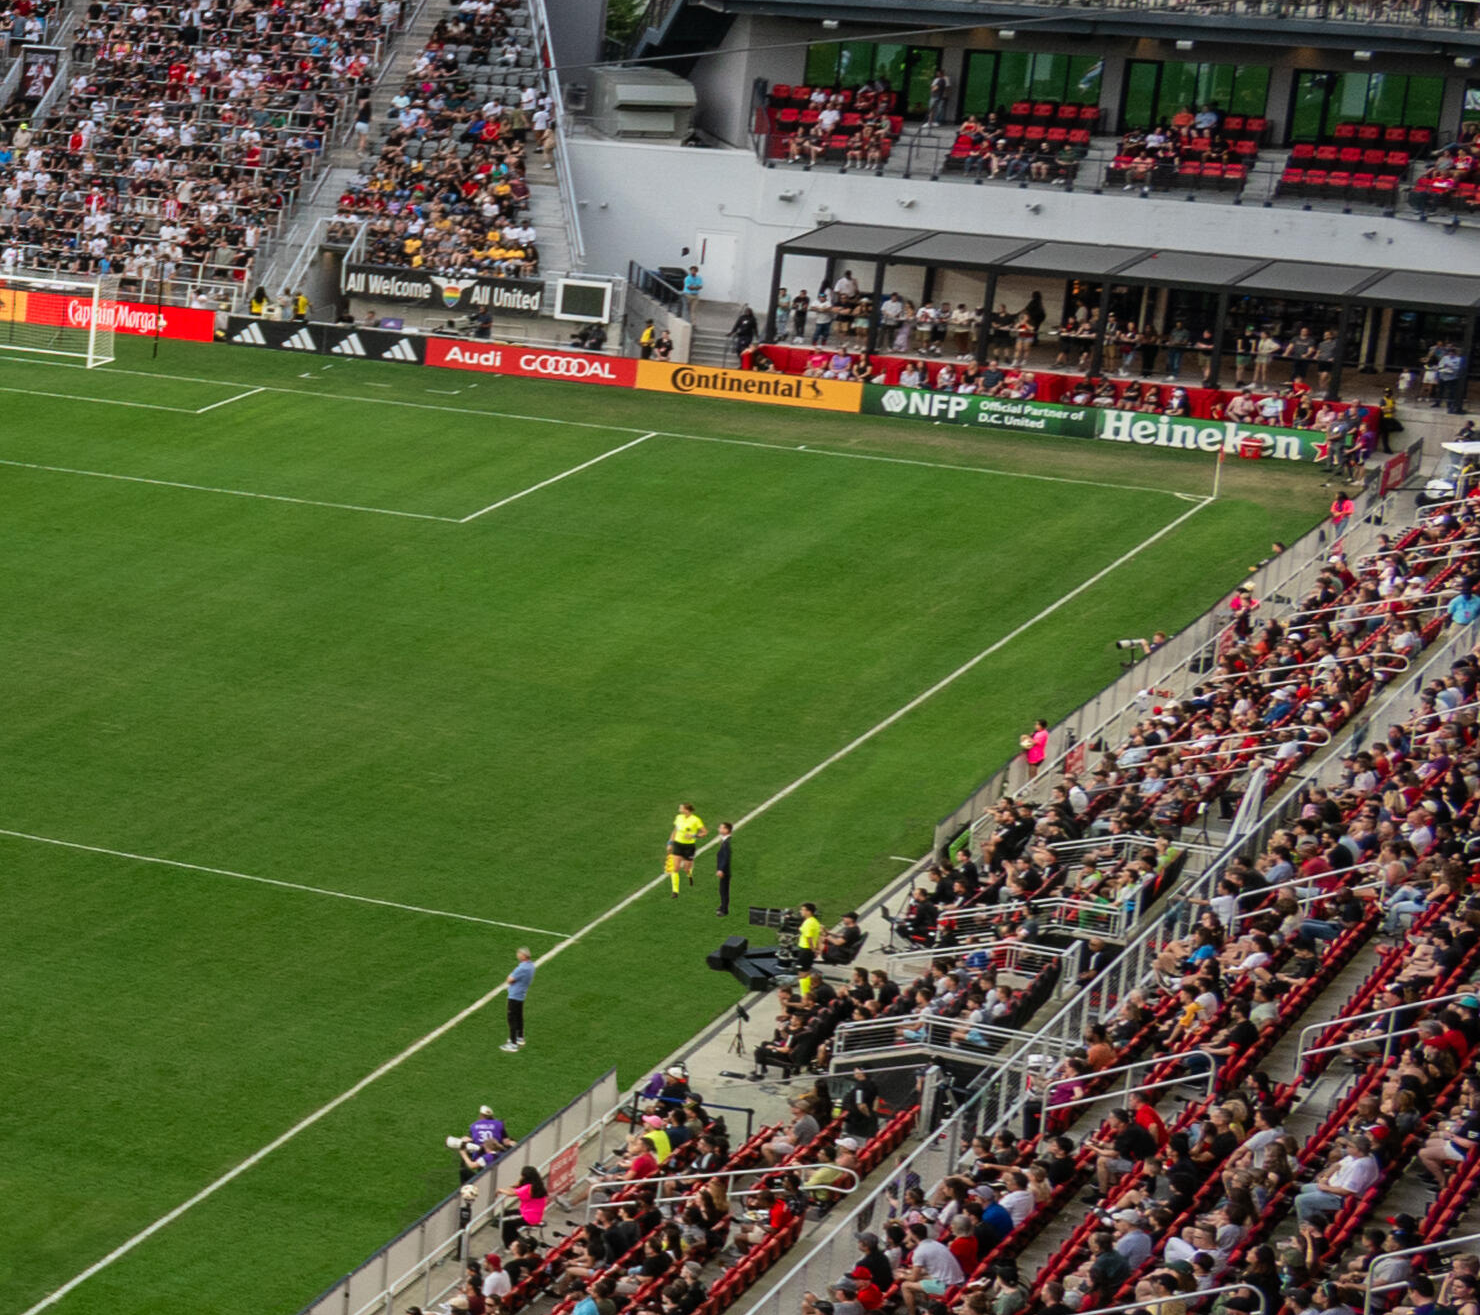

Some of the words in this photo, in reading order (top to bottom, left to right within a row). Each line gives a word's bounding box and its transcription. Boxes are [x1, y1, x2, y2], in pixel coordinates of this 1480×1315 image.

[346, 271, 366, 295] All
[368, 275, 432, 300] Welcome
[470, 285, 490, 306] All
[492, 288, 541, 312] United
[113, 303, 161, 333] Morga
[444, 346, 502, 367] Audi
[670, 366, 801, 399] Continental
[907, 393, 968, 419] NFP
[979, 399, 1014, 414] Official
[1016, 404, 1069, 419] Partner
[1070, 409, 1085, 419] of
[976, 412, 1002, 425] D.C.
[1004, 414, 1046, 429] United
